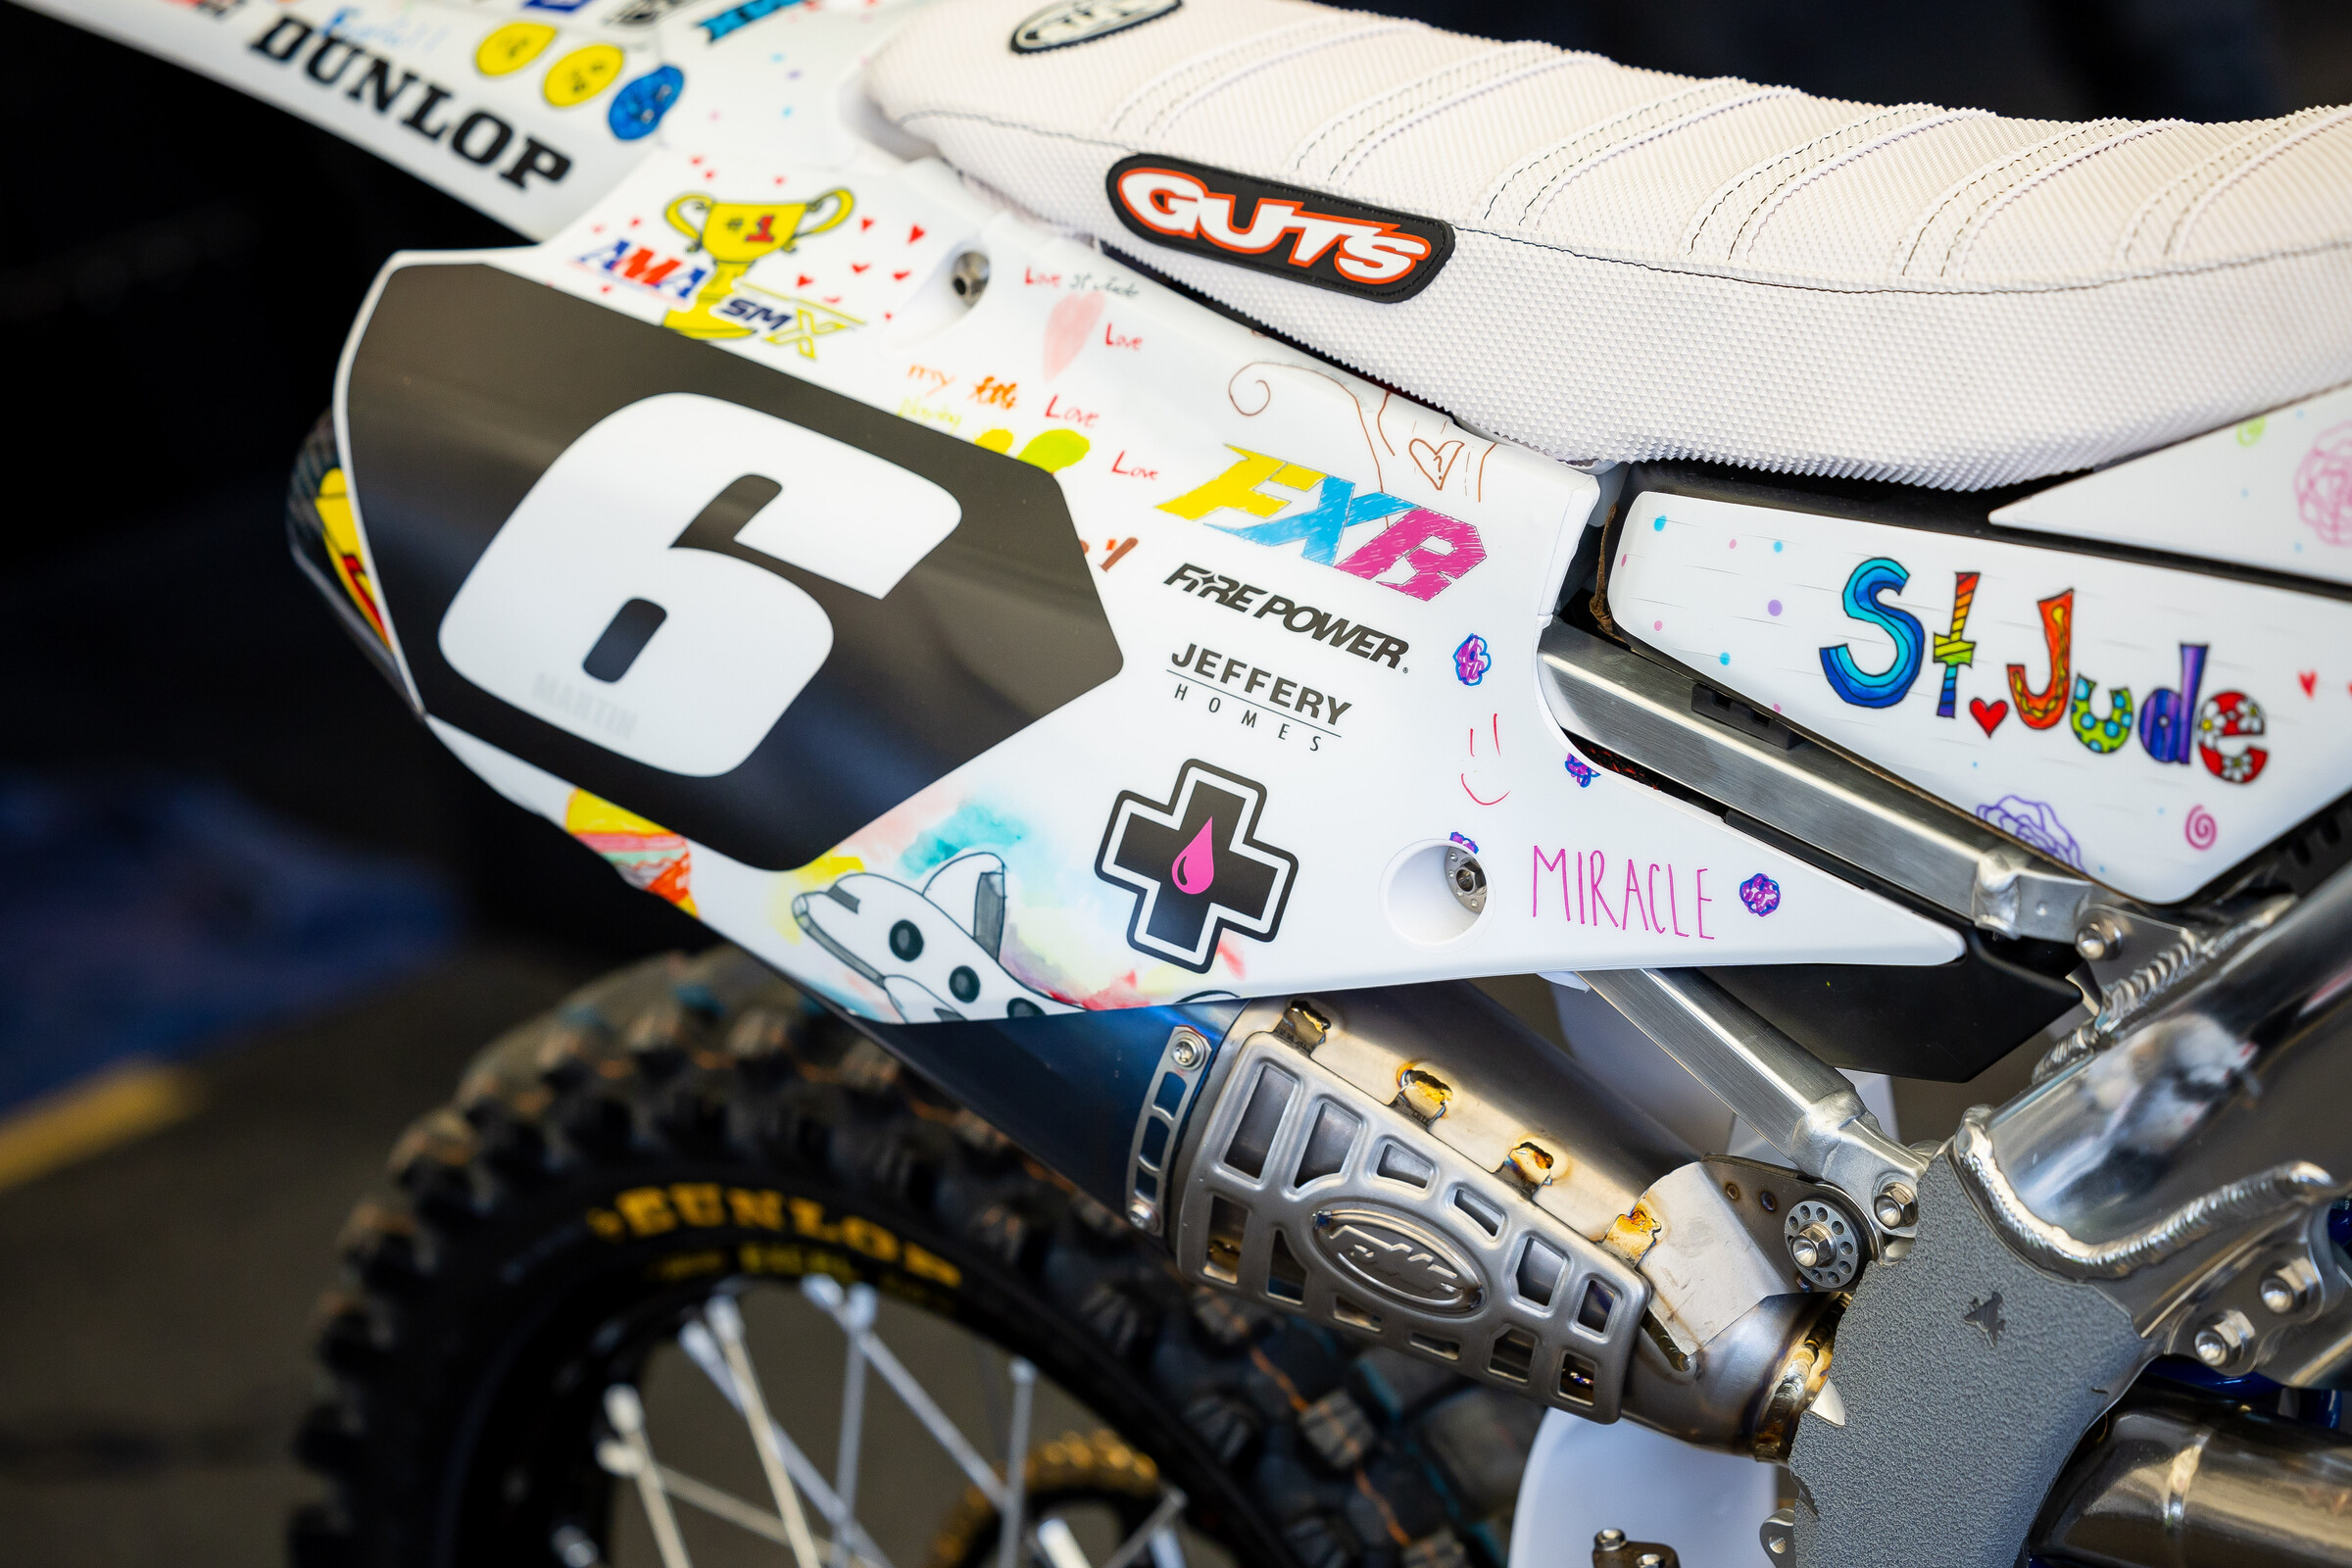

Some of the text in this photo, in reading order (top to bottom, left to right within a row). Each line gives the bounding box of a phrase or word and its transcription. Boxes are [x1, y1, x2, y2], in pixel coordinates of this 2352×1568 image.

[248, 15, 573, 191] DUNLOP
[1117, 167, 1432, 285] GUTS
[576, 238, 708, 300] AMA
[1024, 267, 1061, 287] Love
[1104, 321, 1143, 351] Love
[1045, 394, 1100, 428] Love
[1110, 450, 1159, 481] Love
[1153, 443, 1487, 602] FXR
[438, 392, 962, 777] 6
[1171, 643, 1352, 726] JEFFERY
[1174, 683, 1322, 752] HOMES
[2006, 588, 2269, 784] Jude
[1532, 845, 1715, 940] MIRACLE
